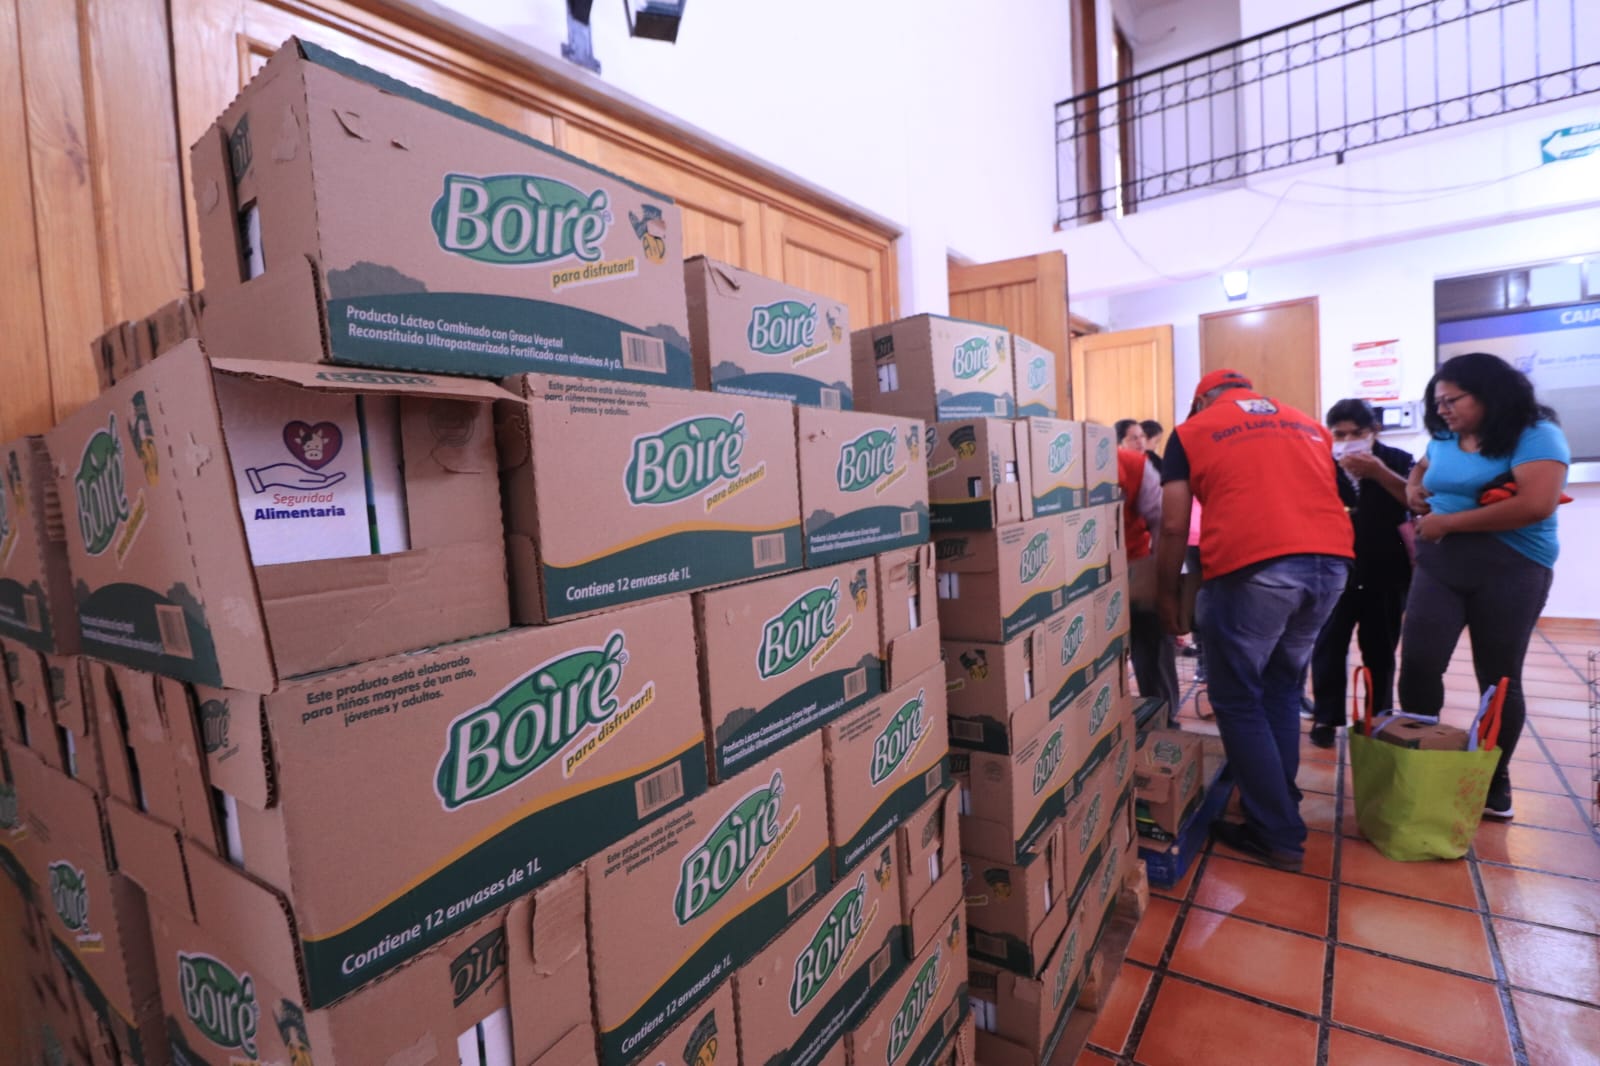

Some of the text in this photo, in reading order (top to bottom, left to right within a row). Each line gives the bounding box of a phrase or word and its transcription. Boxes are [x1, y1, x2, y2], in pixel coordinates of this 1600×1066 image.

[553, 270, 581, 288] para
[346, 305, 564, 349] Producto Lácteo Combinado con Grasa Vegetal
[348, 323, 424, 345] Reconstituido
[425, 334, 510, 356] Ultrapasteurizado
[510, 345, 554, 361] Fortificado
[555, 352, 569, 362] con
[570, 354, 603, 367] vitaminas
[254, 505, 346, 521] Alimentaria
[272, 491, 333, 507] Seguridad
[566, 579, 615, 601] Contiene
[617, 577, 629, 591] 12
[630, 572, 668, 590] envases
[668, 570, 680, 582] de
[302, 669, 477, 724] para niños mayores de un año,
[306, 656, 470, 705] Este producto está elaborado
[344, 692, 443, 727] jóvenes y adultos.
[566, 687, 653, 773] para disfrutar!!
[341, 923, 422, 975] Contiene
[425, 908, 444, 932] 12
[446, 879, 505, 919] envases
[506, 869, 525, 887] de
[621, 1011, 665, 1054] Contiene
[666, 1000, 677, 1018] 12
[678, 974, 711, 1007] envases
[711, 964, 721, 978] de
